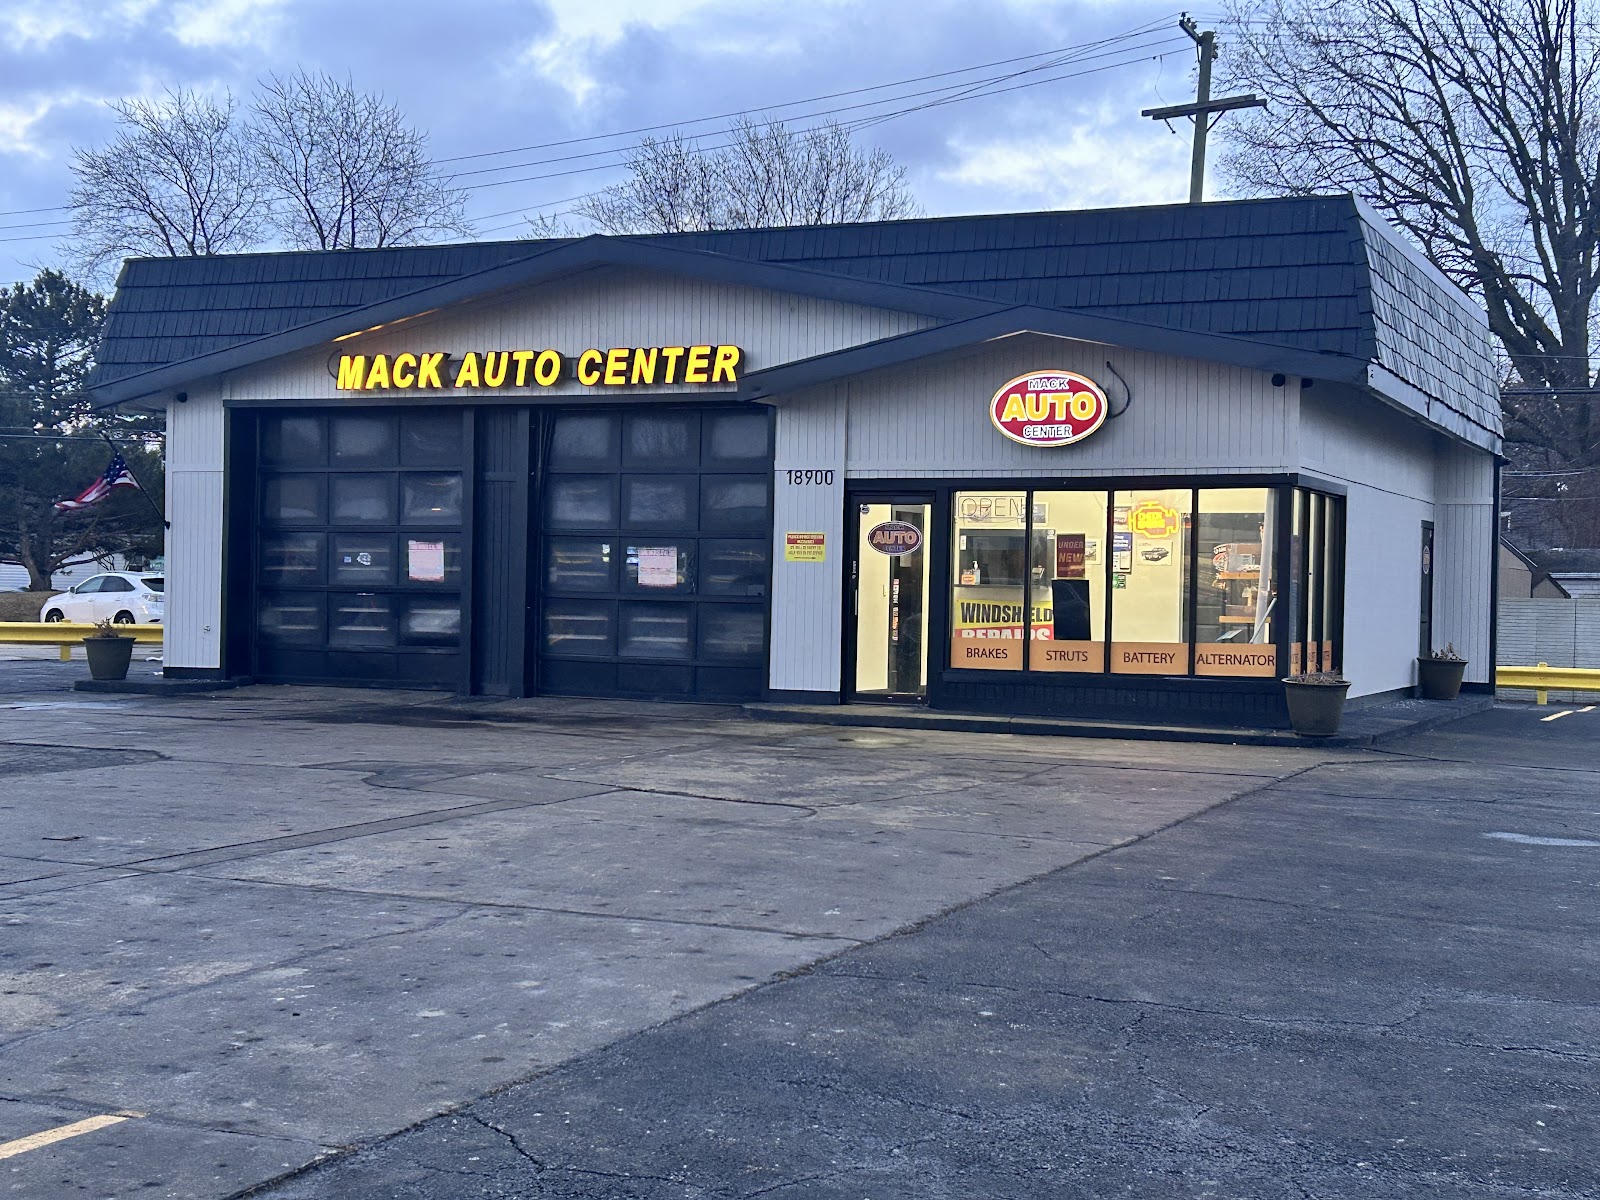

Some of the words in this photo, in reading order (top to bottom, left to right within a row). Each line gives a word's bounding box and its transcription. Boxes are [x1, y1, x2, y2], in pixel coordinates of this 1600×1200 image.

[336, 352, 444, 391] MACK
[455, 349, 561, 388] AUTO
[577, 345, 740, 386] CENTER
[1028, 379, 1069, 390] MACK
[1001, 391, 1097, 422] AUTO
[1023, 425, 1073, 438] CENTER
[786, 470, 834, 486] 18900
[961, 498, 1023, 516] OPEN
[872, 530, 918, 545] AUTO
[1058, 541, 1084, 549] UNDER
[1058, 552, 1084, 563] NEW
[961, 602, 1054, 623] WINDSHELD
[966, 647, 1008, 659] BRAKES
[1045, 650, 1088, 662] STRUTS
[1122, 652, 1175, 664] BATTERY
[1196, 653, 1275, 667] ALTERNATOR
